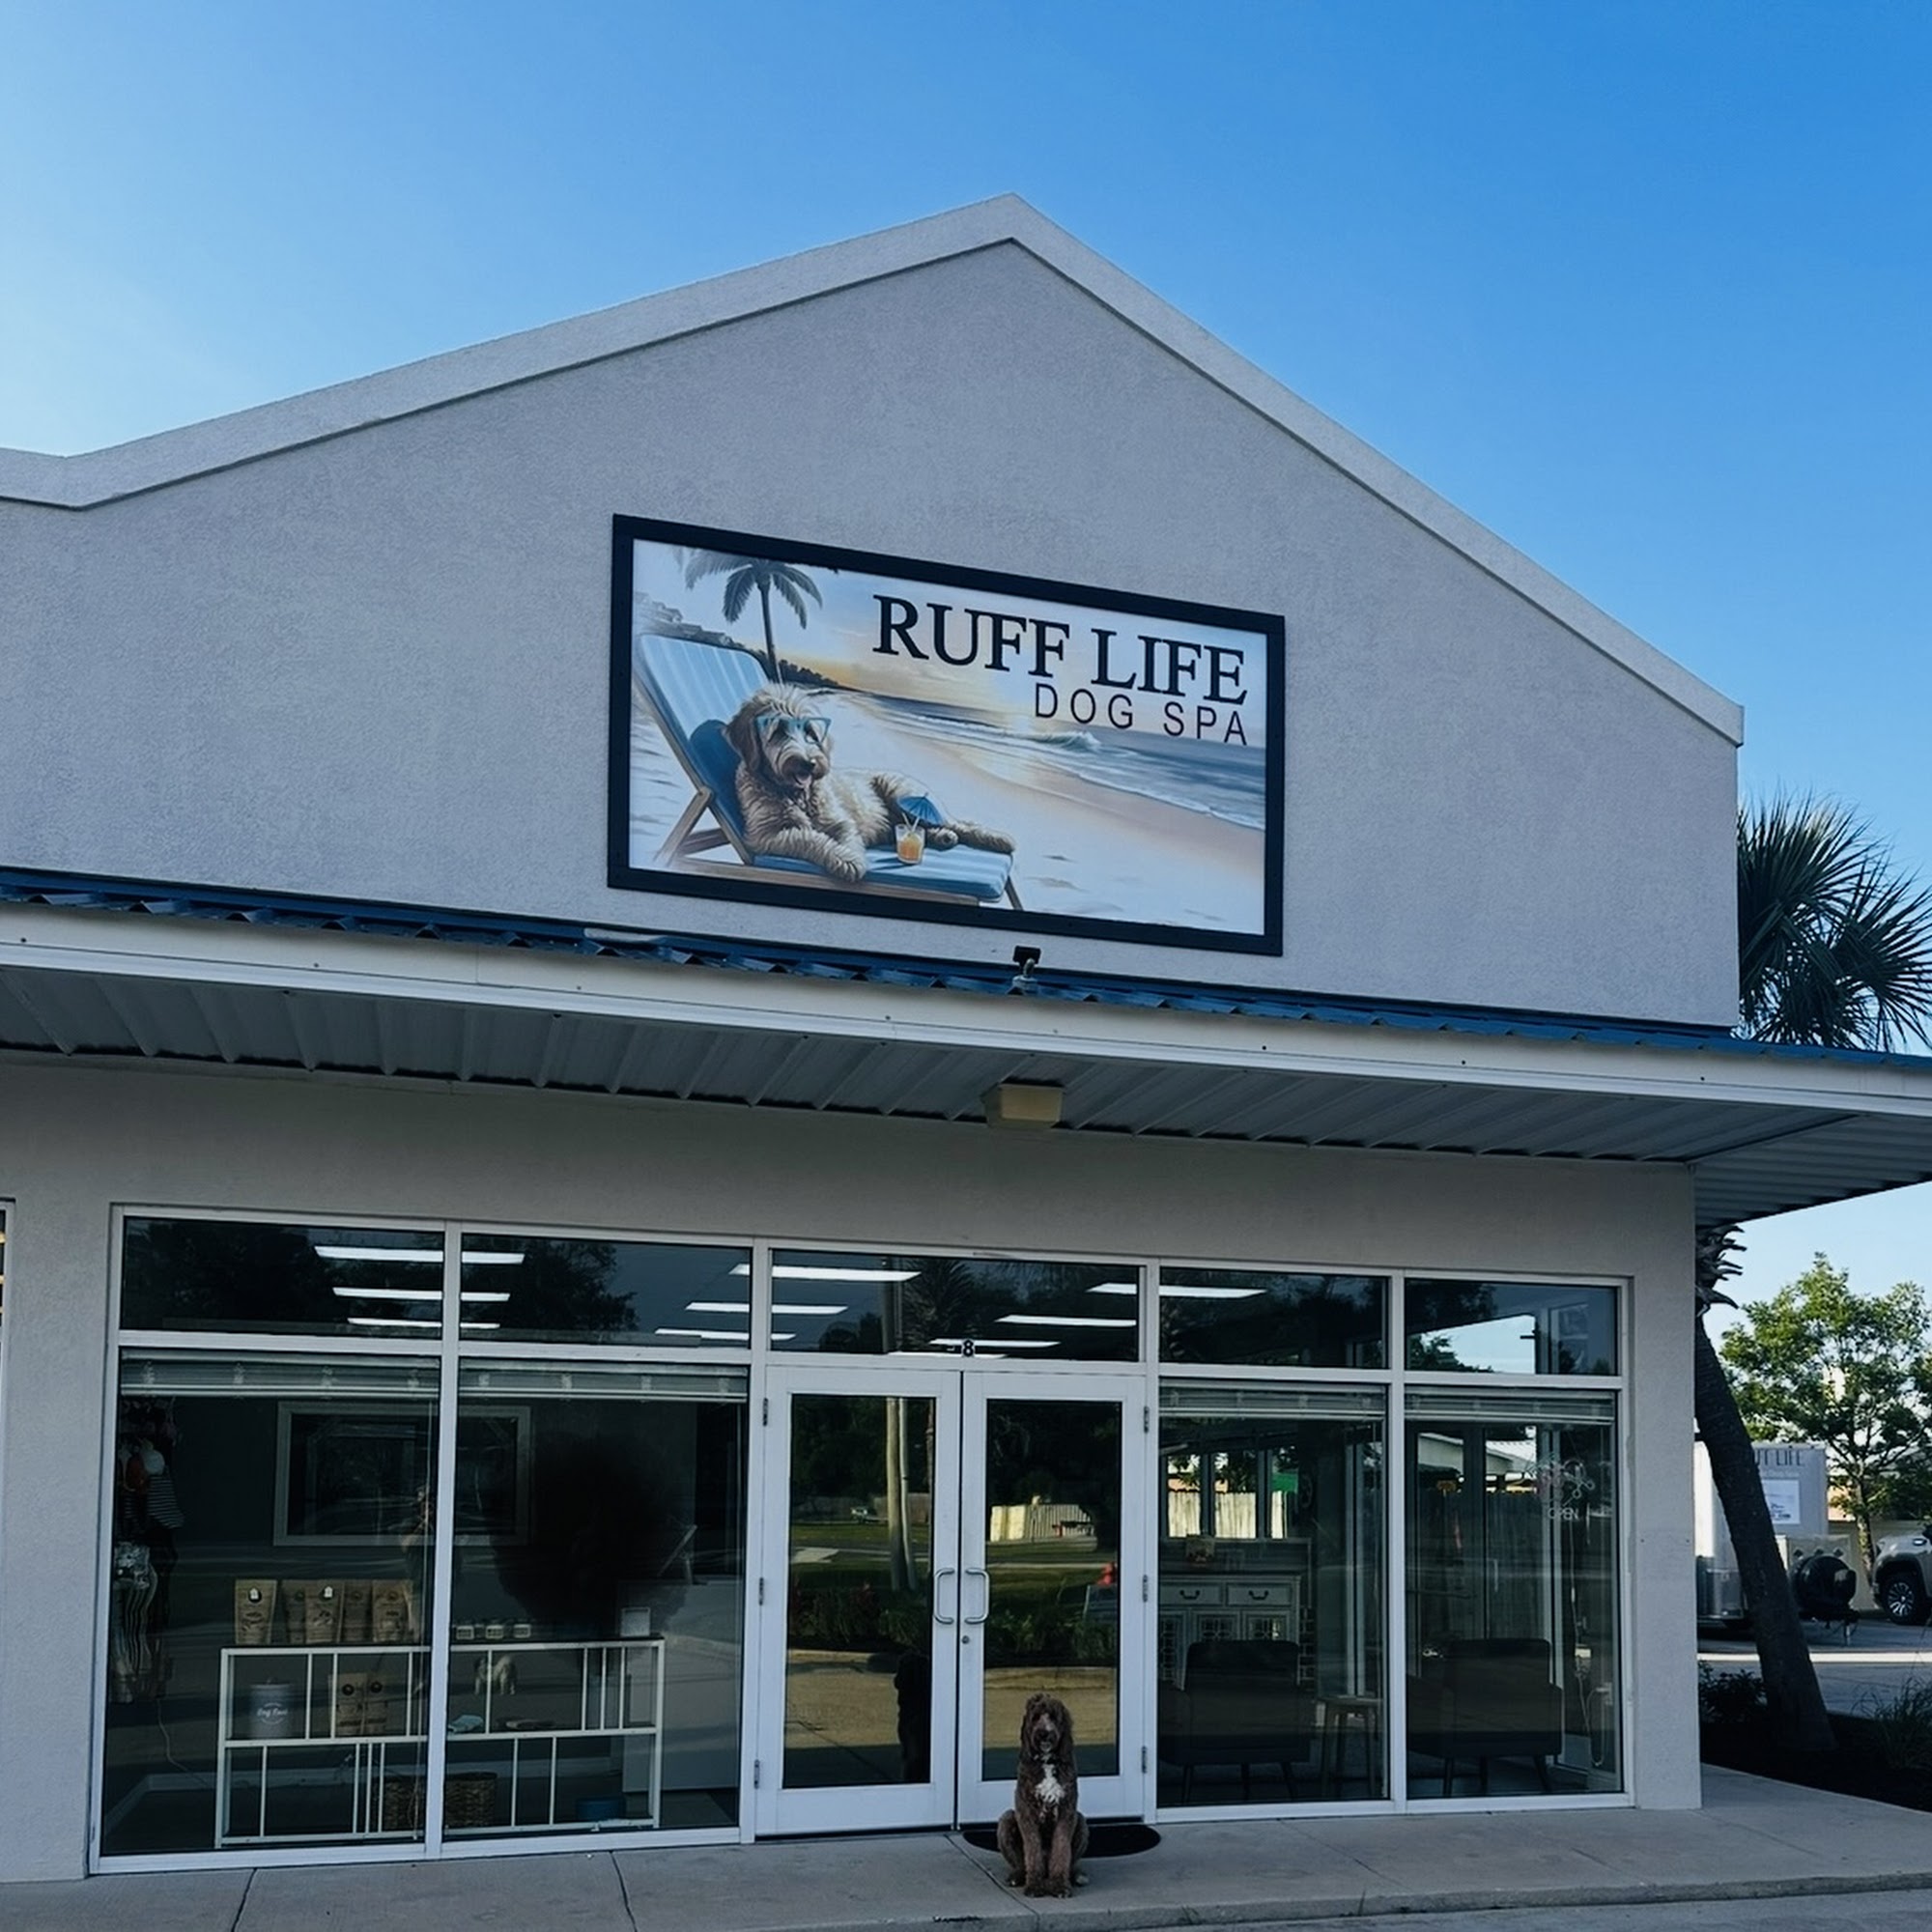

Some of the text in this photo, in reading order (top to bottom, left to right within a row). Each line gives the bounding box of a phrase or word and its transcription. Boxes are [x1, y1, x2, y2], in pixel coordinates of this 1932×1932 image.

[871, 594, 1248, 705] RUFF LIFE
[1036, 682, 1248, 746] DOG SPA
[962, 1339, 975, 1357] 8
